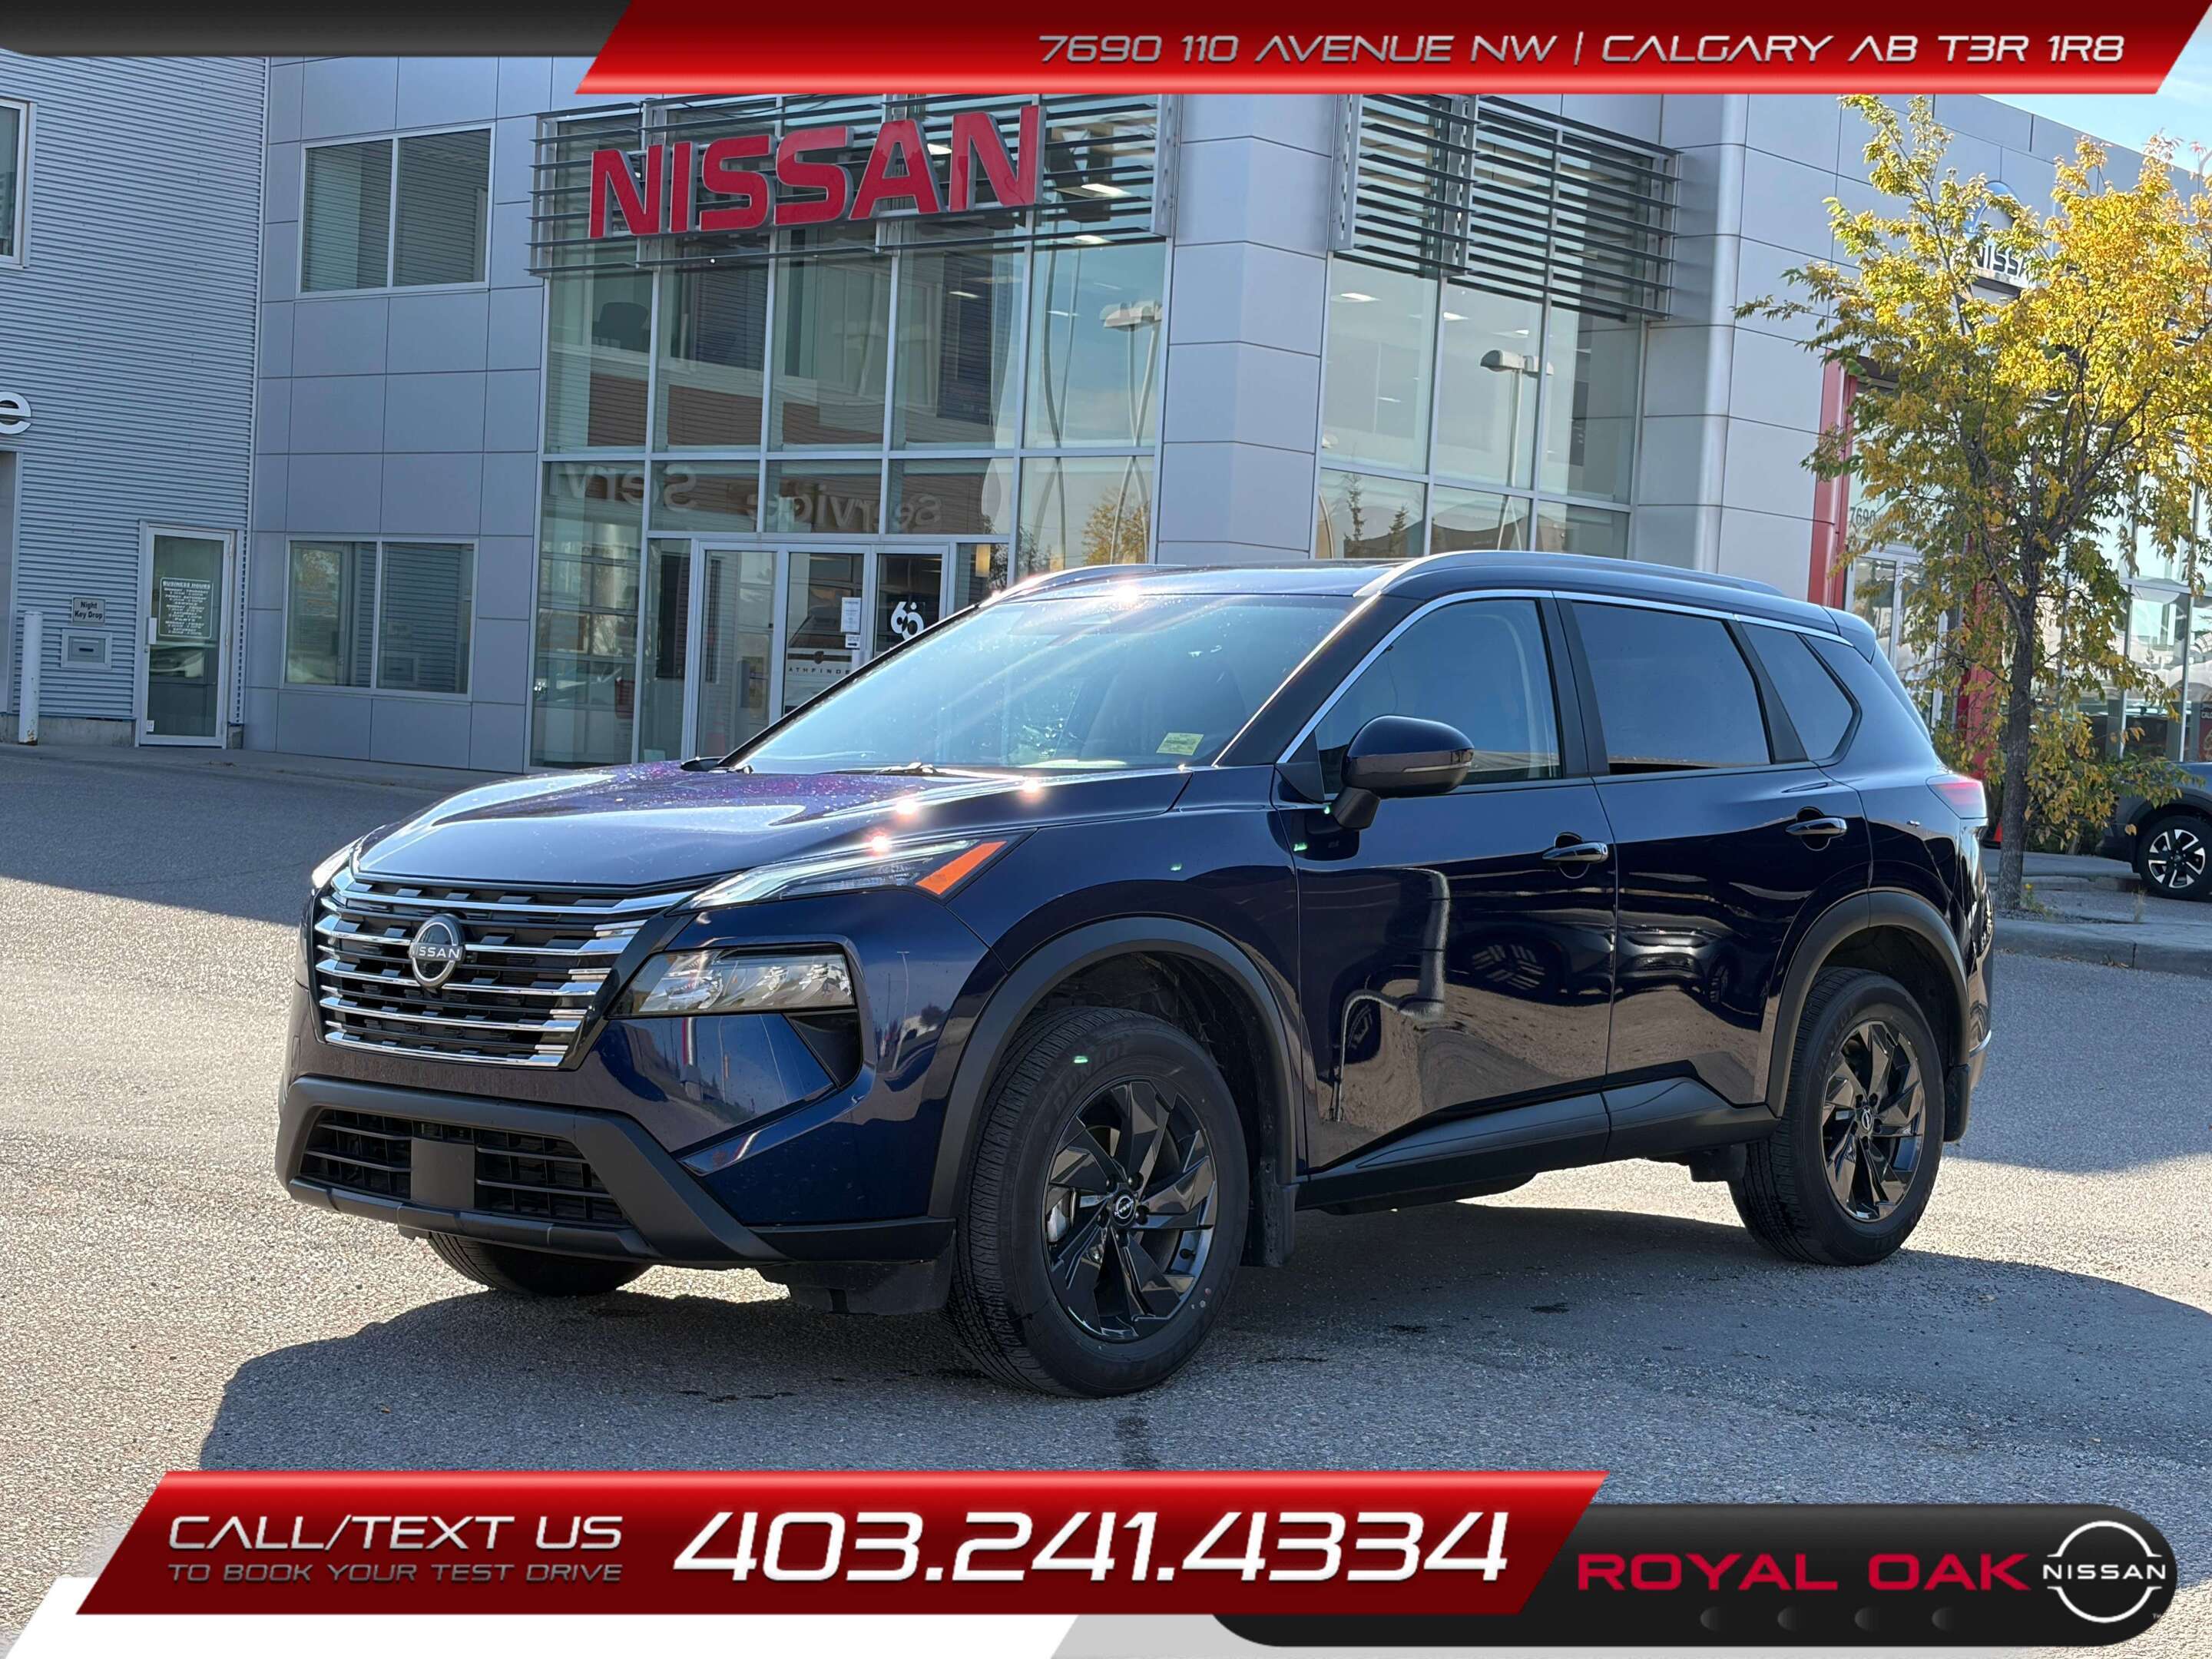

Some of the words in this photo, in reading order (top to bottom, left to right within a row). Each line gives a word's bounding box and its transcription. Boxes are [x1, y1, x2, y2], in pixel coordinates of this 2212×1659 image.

[590, 104, 1042, 238] NISSAN
[80, 601, 98, 610] Night
[75, 611, 87, 620] Key
[88, 611, 103, 621] Drop
